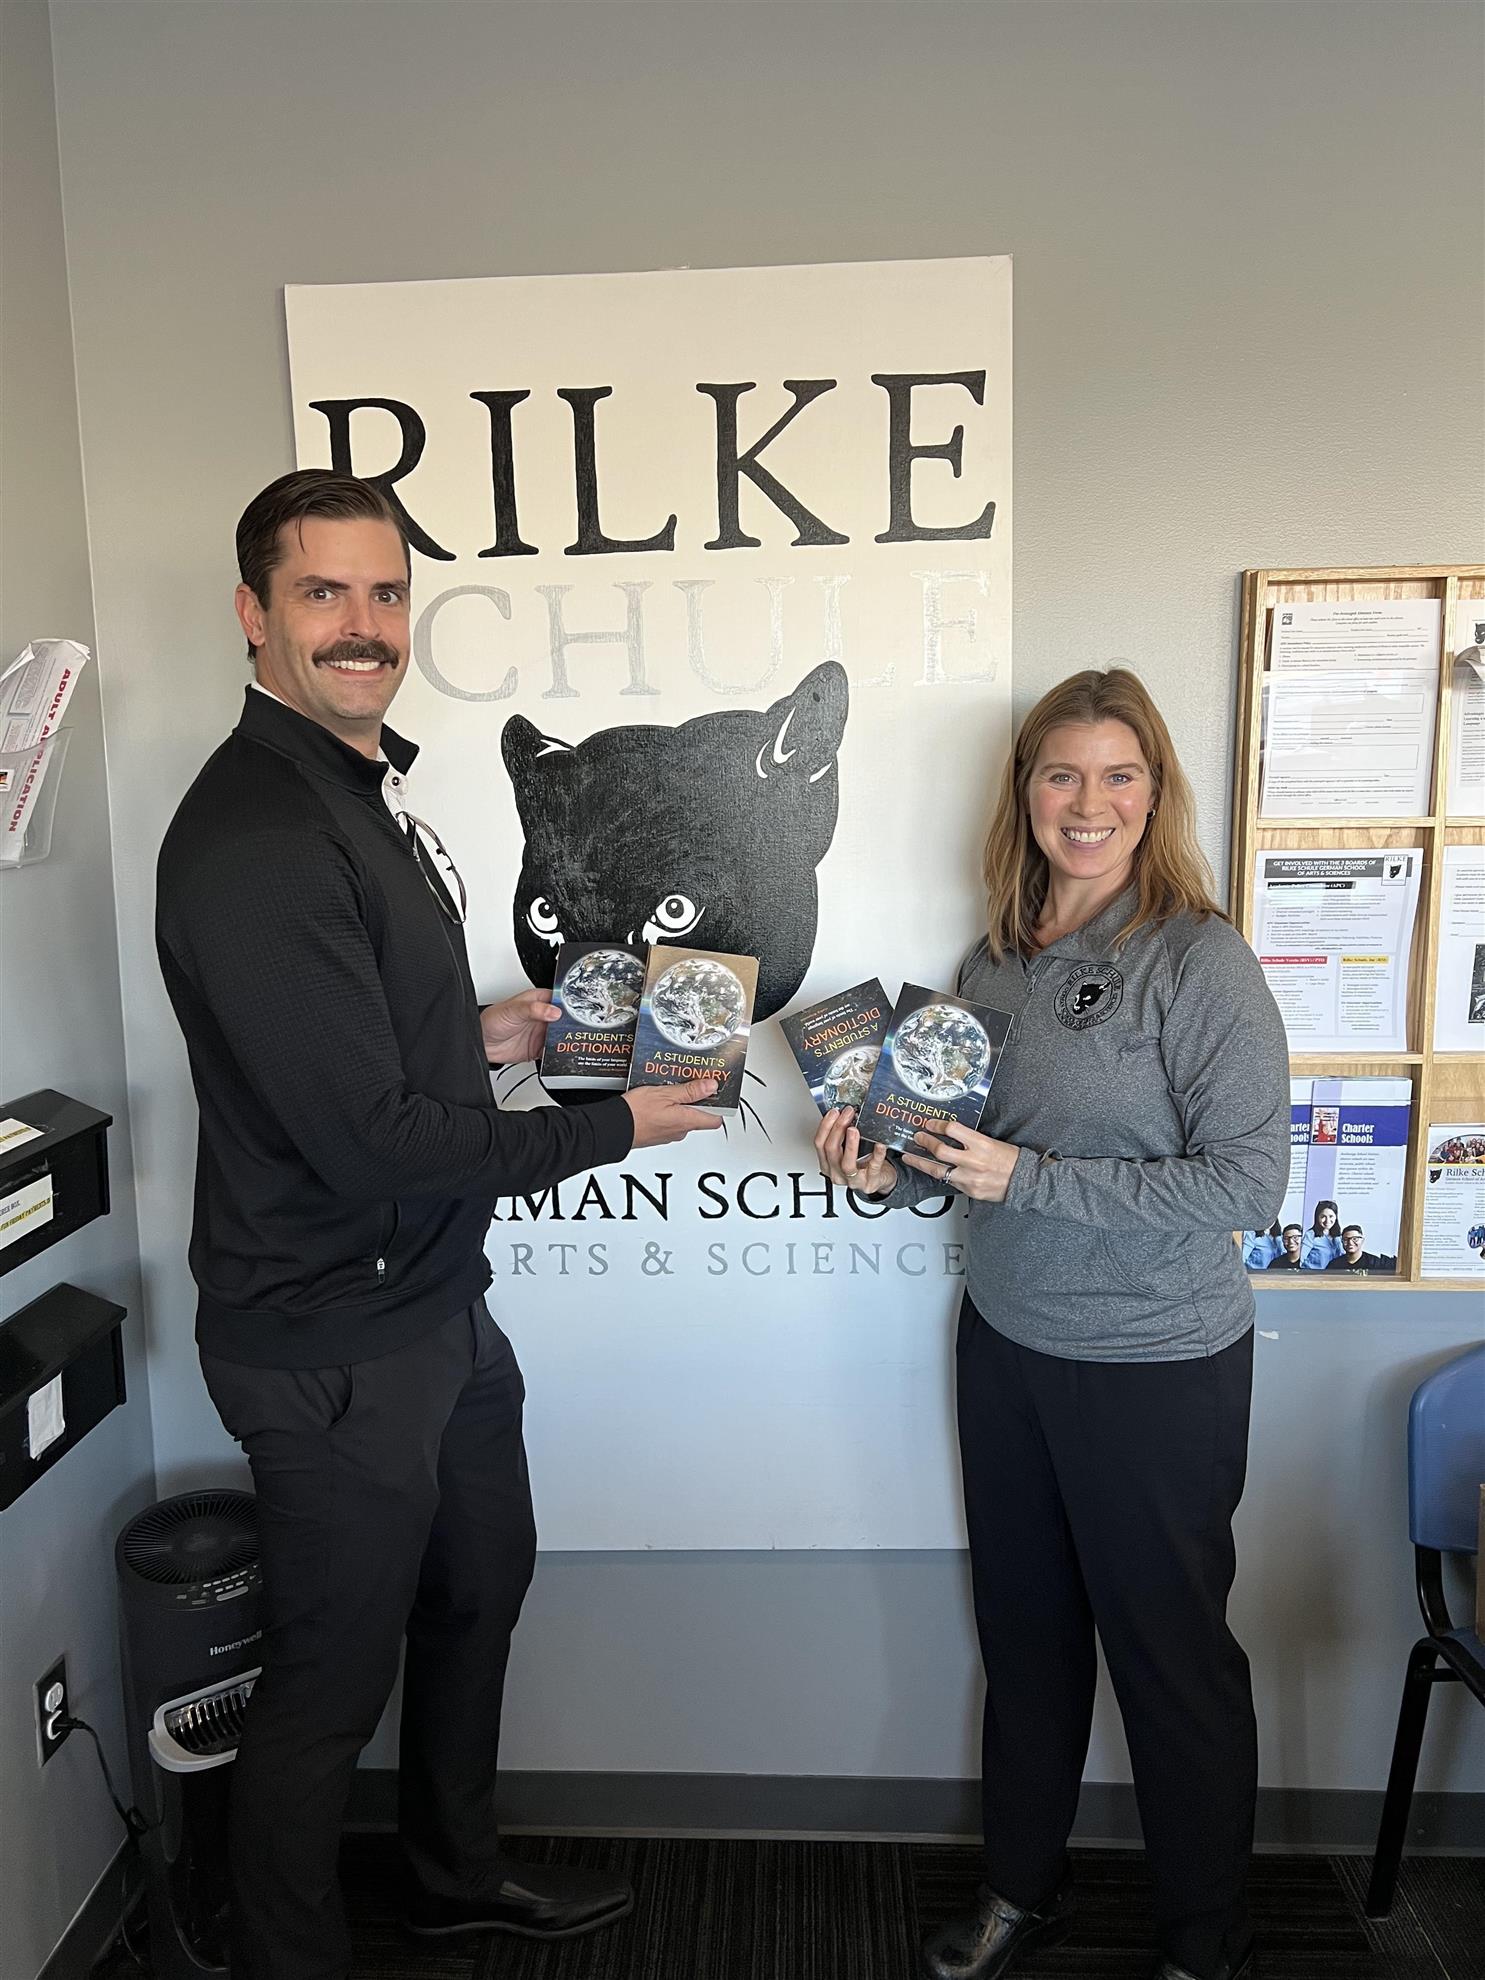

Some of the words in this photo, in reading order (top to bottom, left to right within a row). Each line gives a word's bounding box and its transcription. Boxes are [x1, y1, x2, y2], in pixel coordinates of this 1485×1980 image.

[308, 370, 995, 561] RILKE
[413, 570, 999, 702] CHULE
[48, 668, 72, 720] ADULT
[1067, 967, 1094, 986] RILKE
[1096, 967, 1121, 992] SCHULE
[565, 1032, 573, 1041] A
[575, 1032, 634, 1043] STUDENT'S
[804, 1007, 880, 1050] DICTIONARY
[870, 1022, 879, 1032] A
[556, 1042, 634, 1054] DICTIONAR
[814, 1026, 871, 1058] STUDENT'S
[653, 1051, 662, 1060] A
[664, 1052, 726, 1067] STUDENT'S
[644, 1062, 732, 1082] DICTIONARY
[886, 1093, 896, 1103] A
[897, 1096, 958, 1122] STUDENT'S
[1341, 1133, 1374, 1144] Schools
[1342, 1123, 1375, 1133] Charter
[1446, 1168, 1469, 1177] Rilke
[492, 1173, 674, 1222] MAN
[698, 1172, 969, 1219] SCHOO
[492, 1242, 608, 1276] RTS
[640, 1241, 675, 1276] &
[706, 1242, 966, 1276] SCIENCE
[210, 1630, 262, 1656] Honeywell
